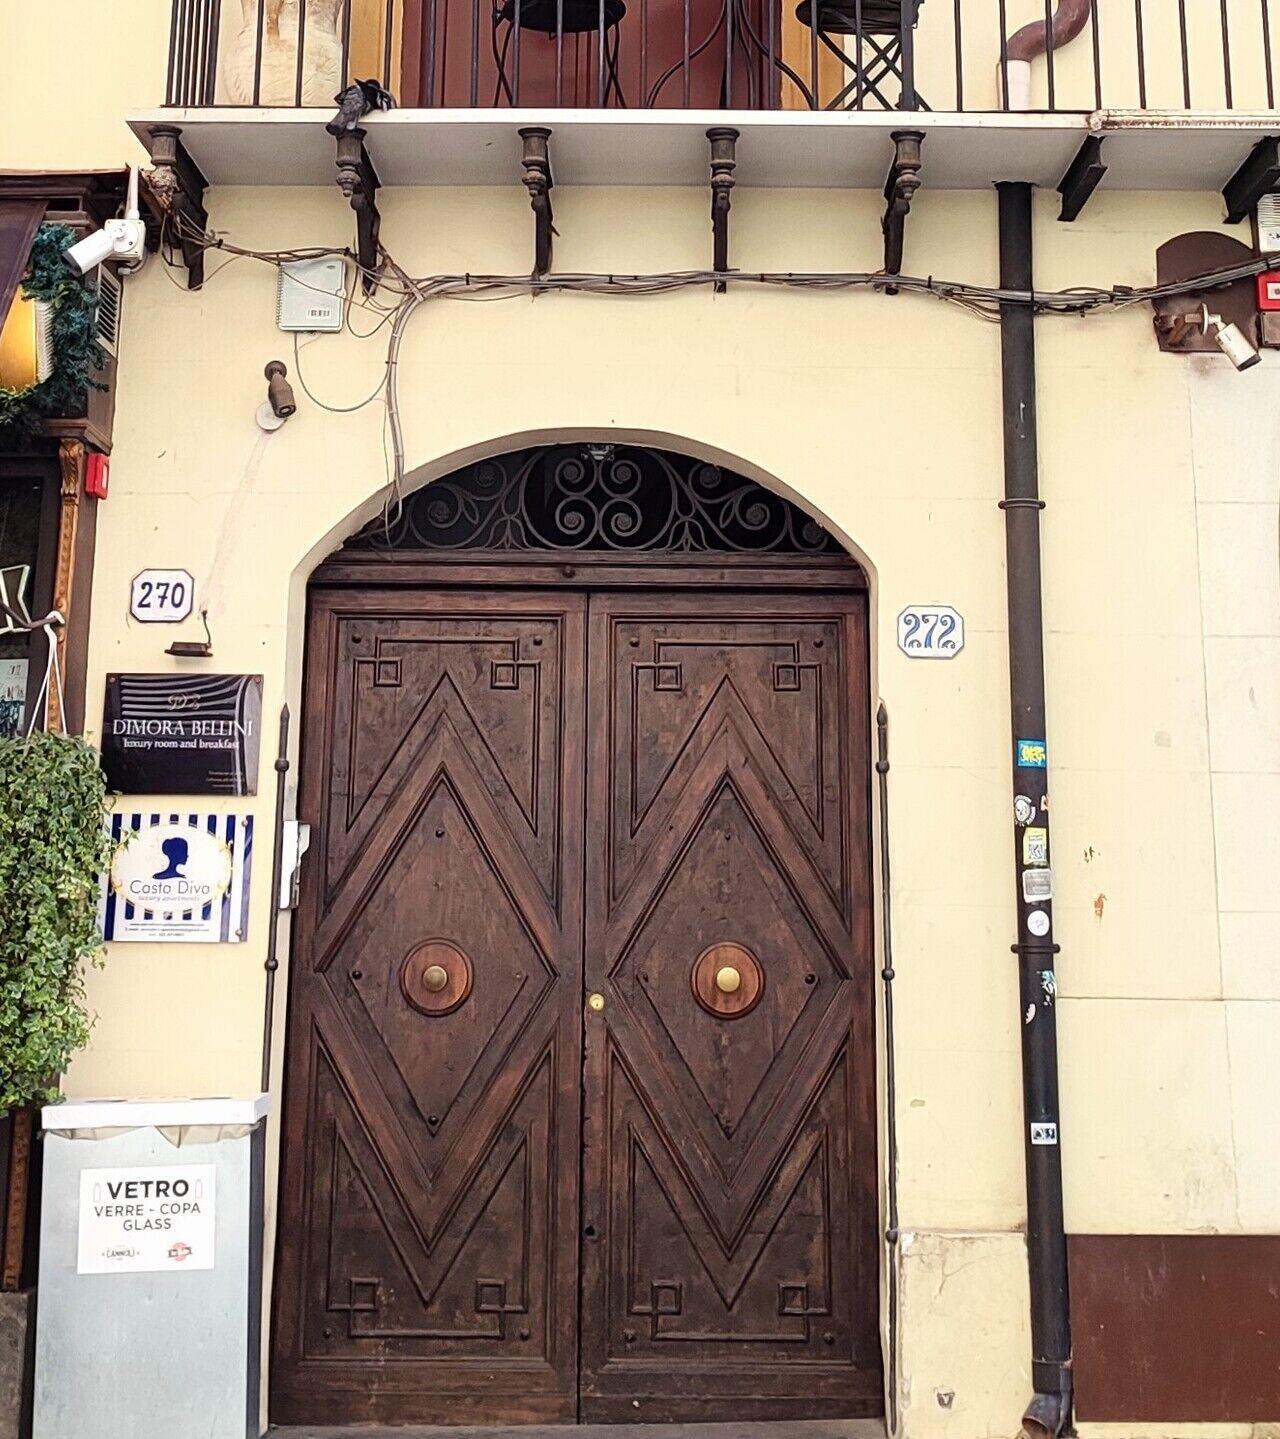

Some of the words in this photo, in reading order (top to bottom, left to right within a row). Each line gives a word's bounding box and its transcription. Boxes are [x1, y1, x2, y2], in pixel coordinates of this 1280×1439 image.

[137, 581, 185, 610] 270
[903, 612, 956, 649] 272
[113, 719, 185, 736] DIMORA
[191, 720, 253, 737] BELLINI
[123, 738, 152, 750] luxury
[154, 740, 178, 748] room
[180, 739, 197, 748] and
[199, 739, 240, 749] breakfast
[107, 1179, 189, 1199] VETRO
[94, 1204, 144, 1217] VERRE
[160, 1202, 201, 1215] COPA
[123, 1218, 172, 1231] GLASS
